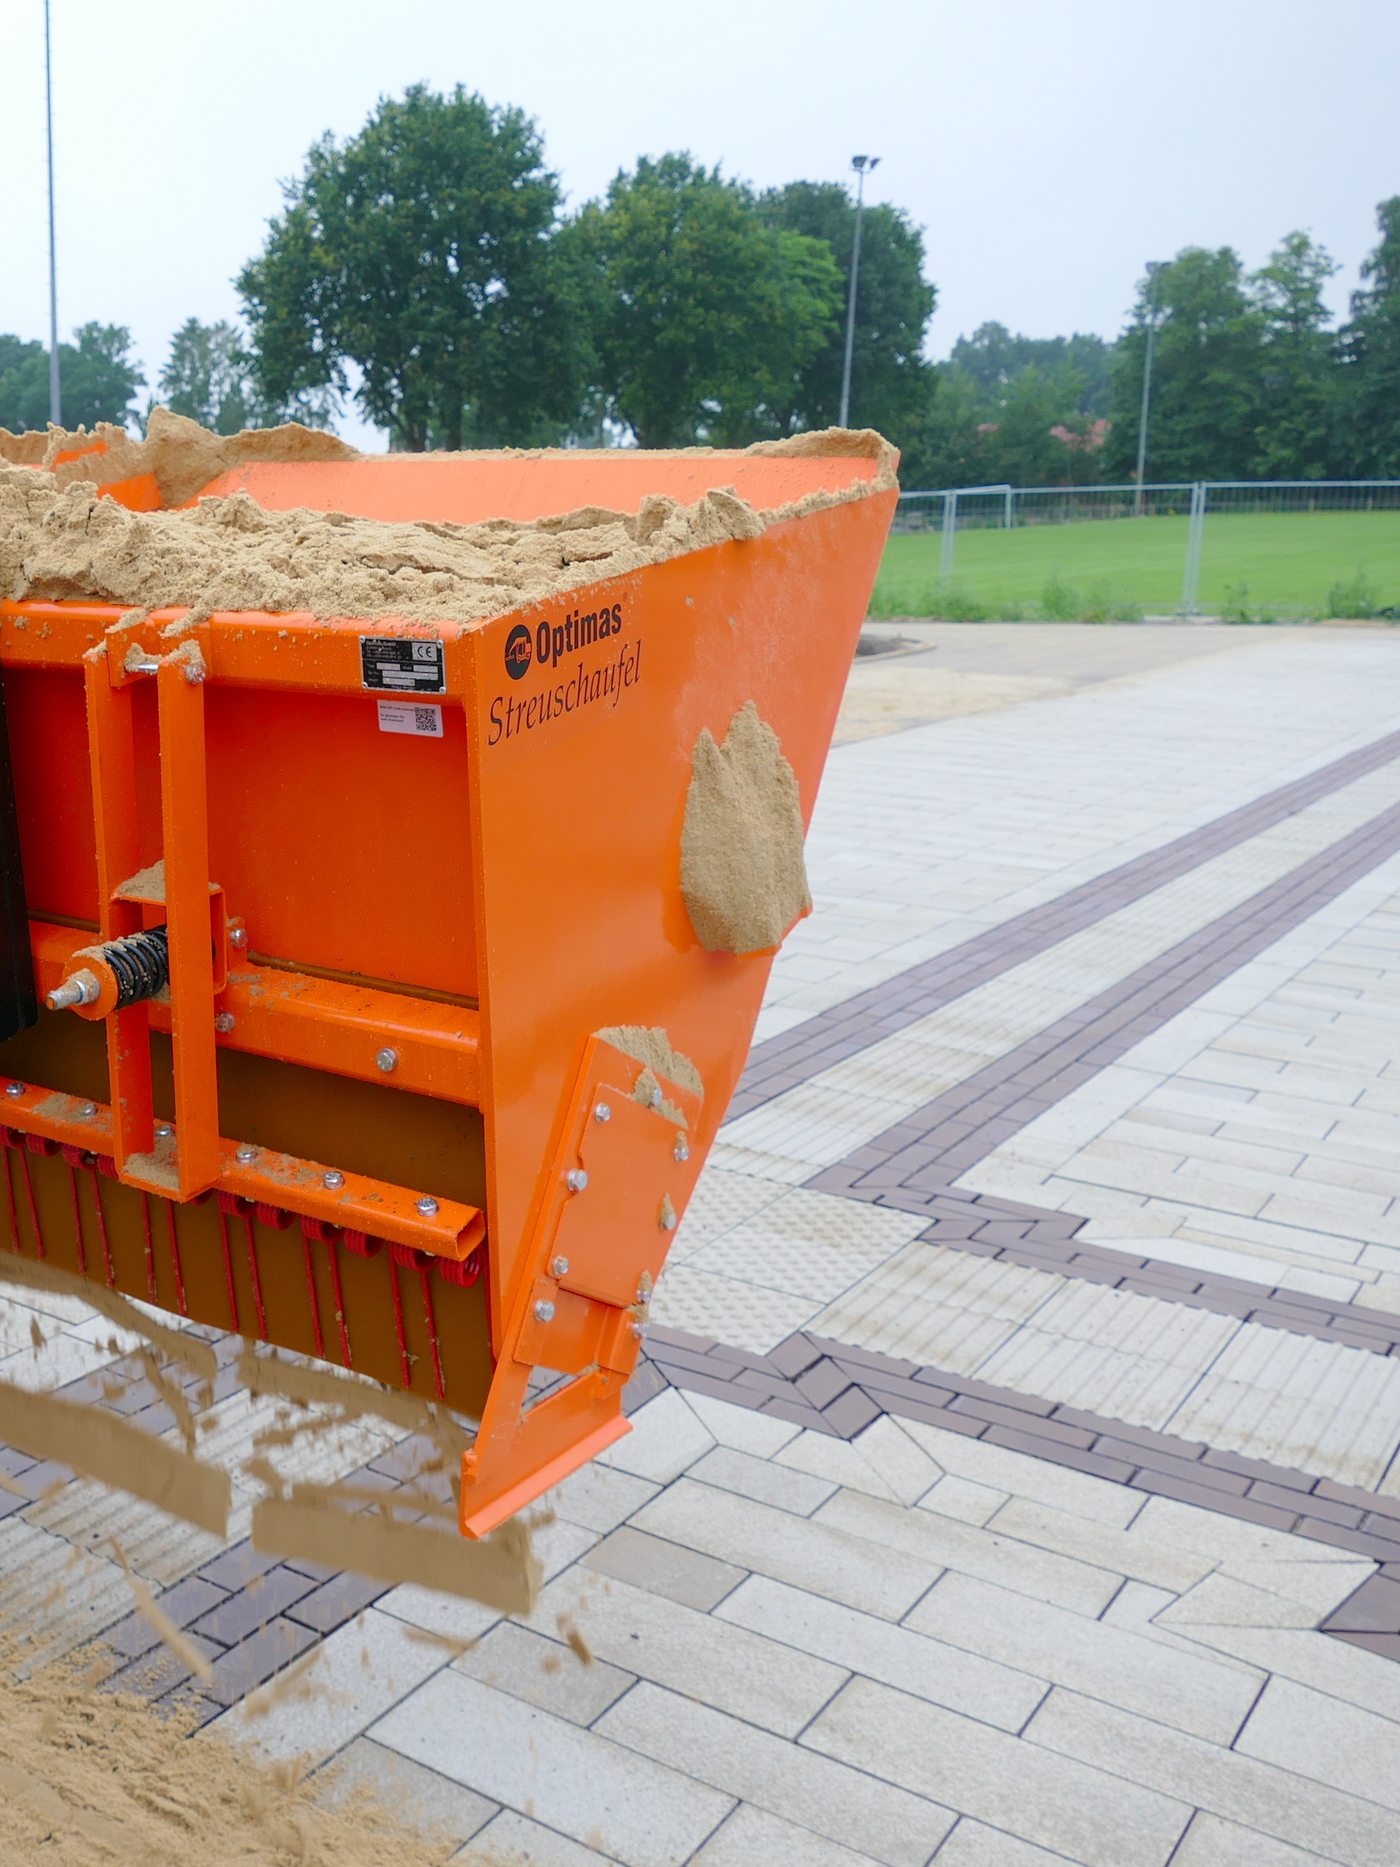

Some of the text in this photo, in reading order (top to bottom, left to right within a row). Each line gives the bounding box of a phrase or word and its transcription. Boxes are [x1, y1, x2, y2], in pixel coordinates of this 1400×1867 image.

[417, 645, 433, 658] CE
[536, 603, 622, 669] Optimas
[488, 639, 642, 746] Streuschaufel
